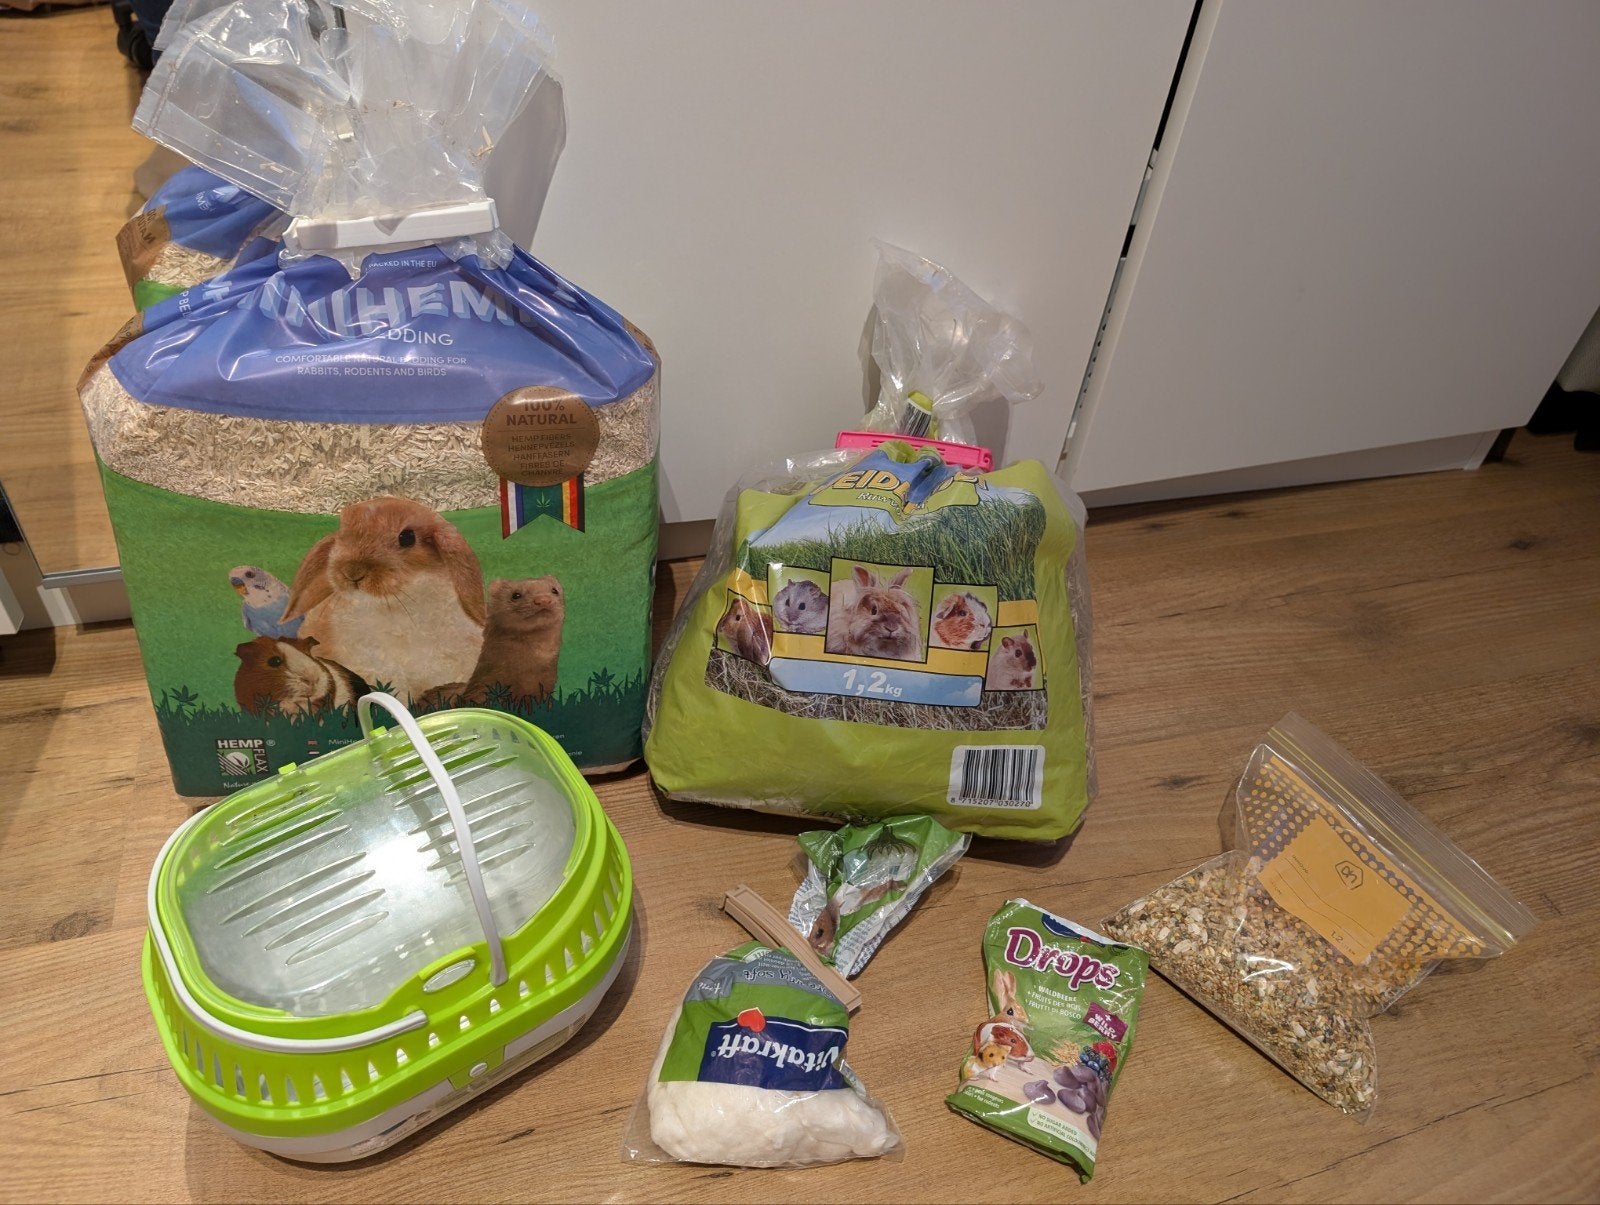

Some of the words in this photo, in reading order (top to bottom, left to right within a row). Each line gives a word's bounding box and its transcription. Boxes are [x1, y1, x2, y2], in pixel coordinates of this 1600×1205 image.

[410, 260, 426, 268] THE
[427, 260, 437, 268] EU
[275, 354, 352, 364] COMFORTABLE
[447, 356, 467, 365] FOR
[297, 366, 342, 377] RABBITS,
[344, 366, 392, 377] RODENTS
[393, 367, 415, 377] AND
[417, 367, 447, 377] BIRDS
[506, 413, 578, 426] NATURAL
[216, 738, 263, 750] HEMP
[252, 747, 269, 773] FLAX
[1005, 928, 1120, 991] Drops
[1031, 991, 1053, 1005] FRUITS
[1059, 1008, 1082, 1020] BOSCO
[1087, 1017, 1118, 1040] BERRY
[1094, 1013, 1116, 1034] WILD
